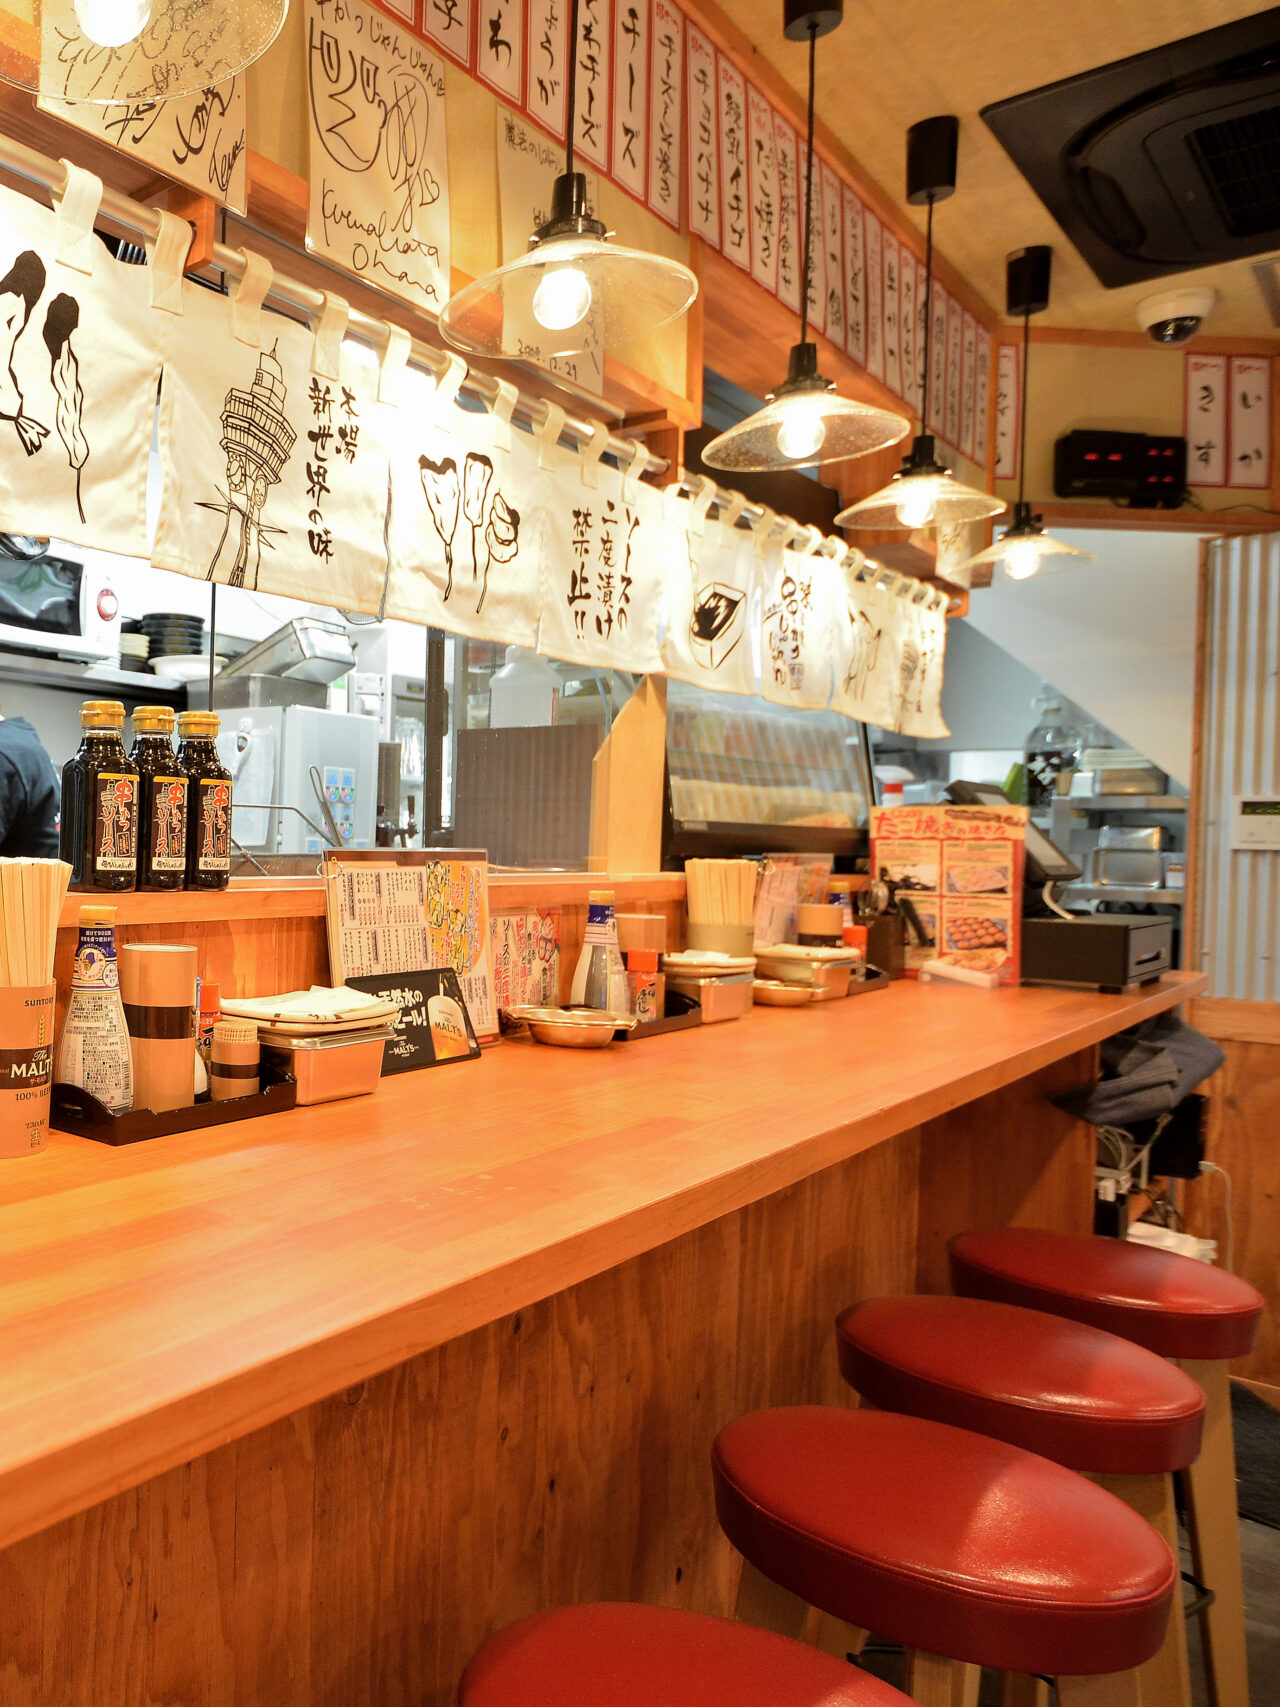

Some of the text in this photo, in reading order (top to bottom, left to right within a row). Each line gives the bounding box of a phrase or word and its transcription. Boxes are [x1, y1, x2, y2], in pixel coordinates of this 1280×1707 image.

[306, 377, 335, 565] 新世界の味
[595, 500, 618, 641] 二度漬け
[113, 776, 133, 832] 串かつ
[167, 779, 184, 833] 串かつ
[212, 782, 228, 834] 串かつ
[100, 806, 115, 853] ソース
[155, 809, 170, 853] ソース
[202, 810, 215, 853] ソース
[15, 1091, 38, 1102] 100%
[30, 1129, 41, 1142] 生
